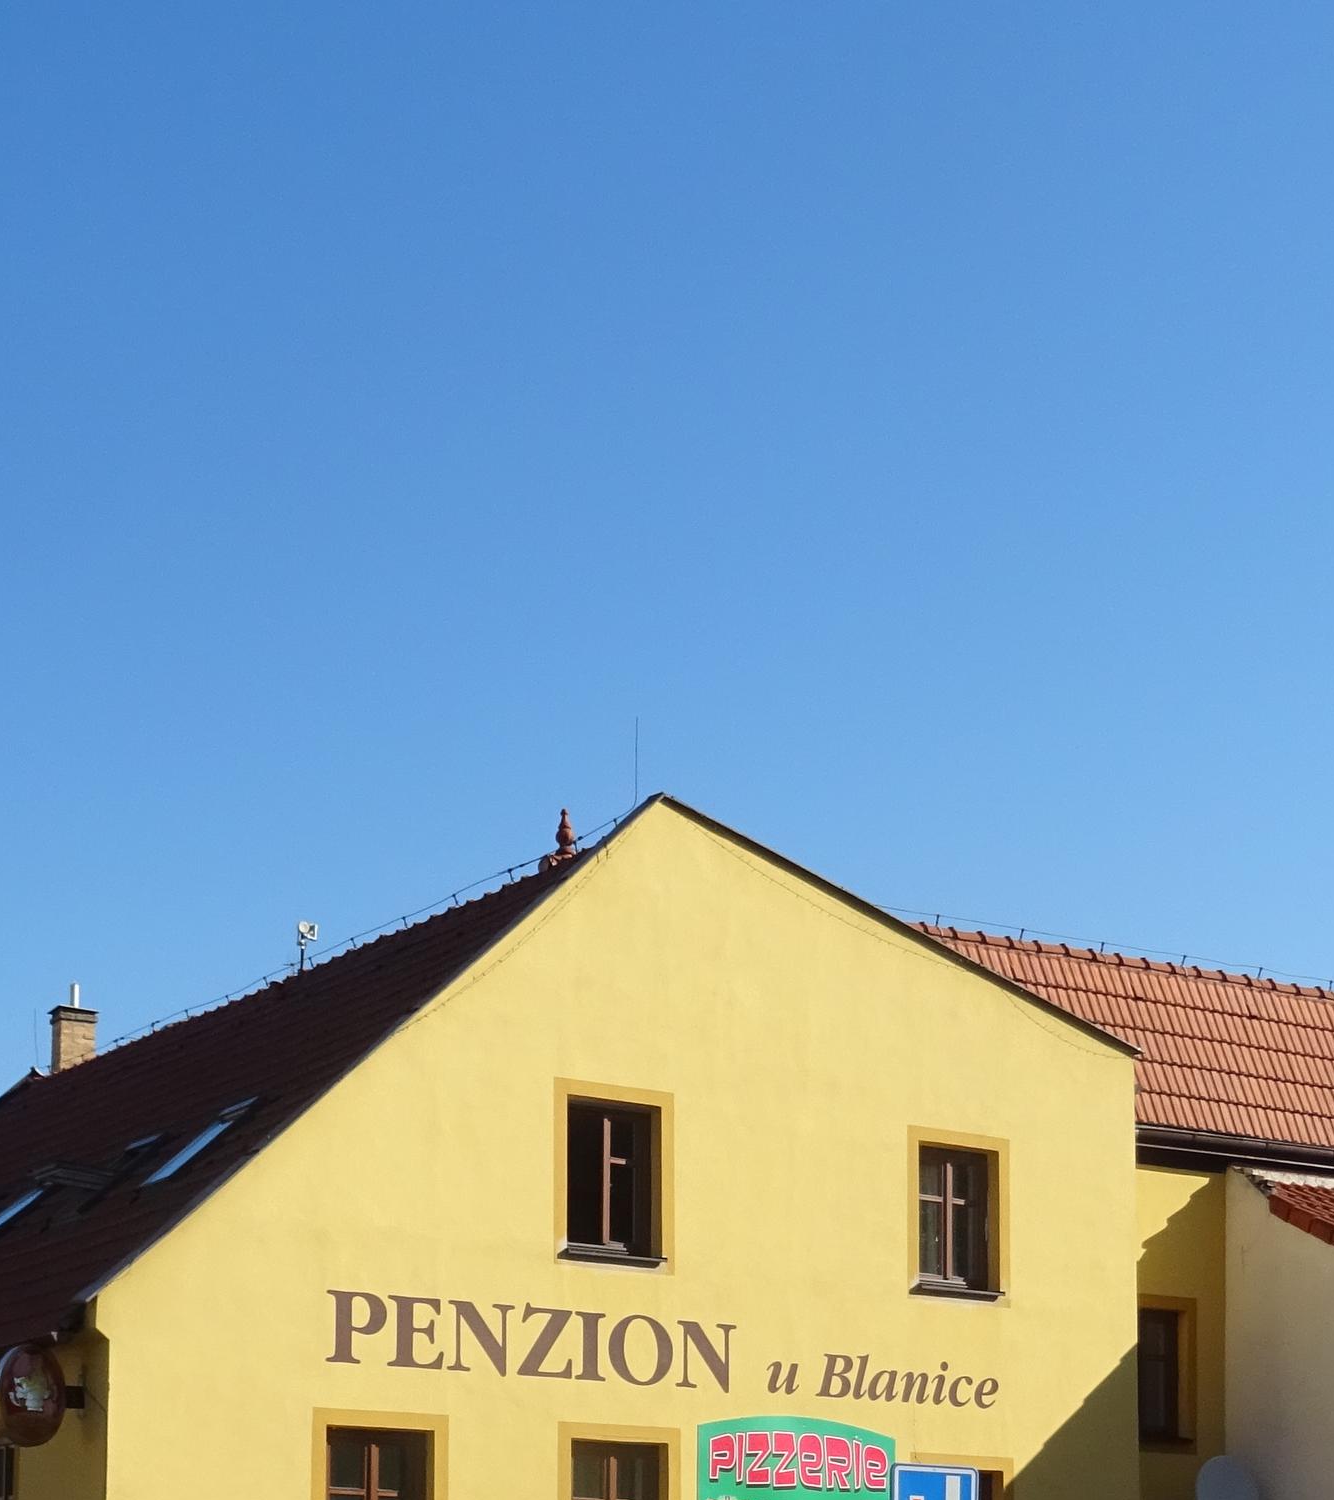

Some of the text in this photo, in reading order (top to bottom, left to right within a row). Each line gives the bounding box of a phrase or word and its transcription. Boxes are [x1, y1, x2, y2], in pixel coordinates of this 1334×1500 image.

[325, 1289, 1000, 1411] PENZION u Blanice
